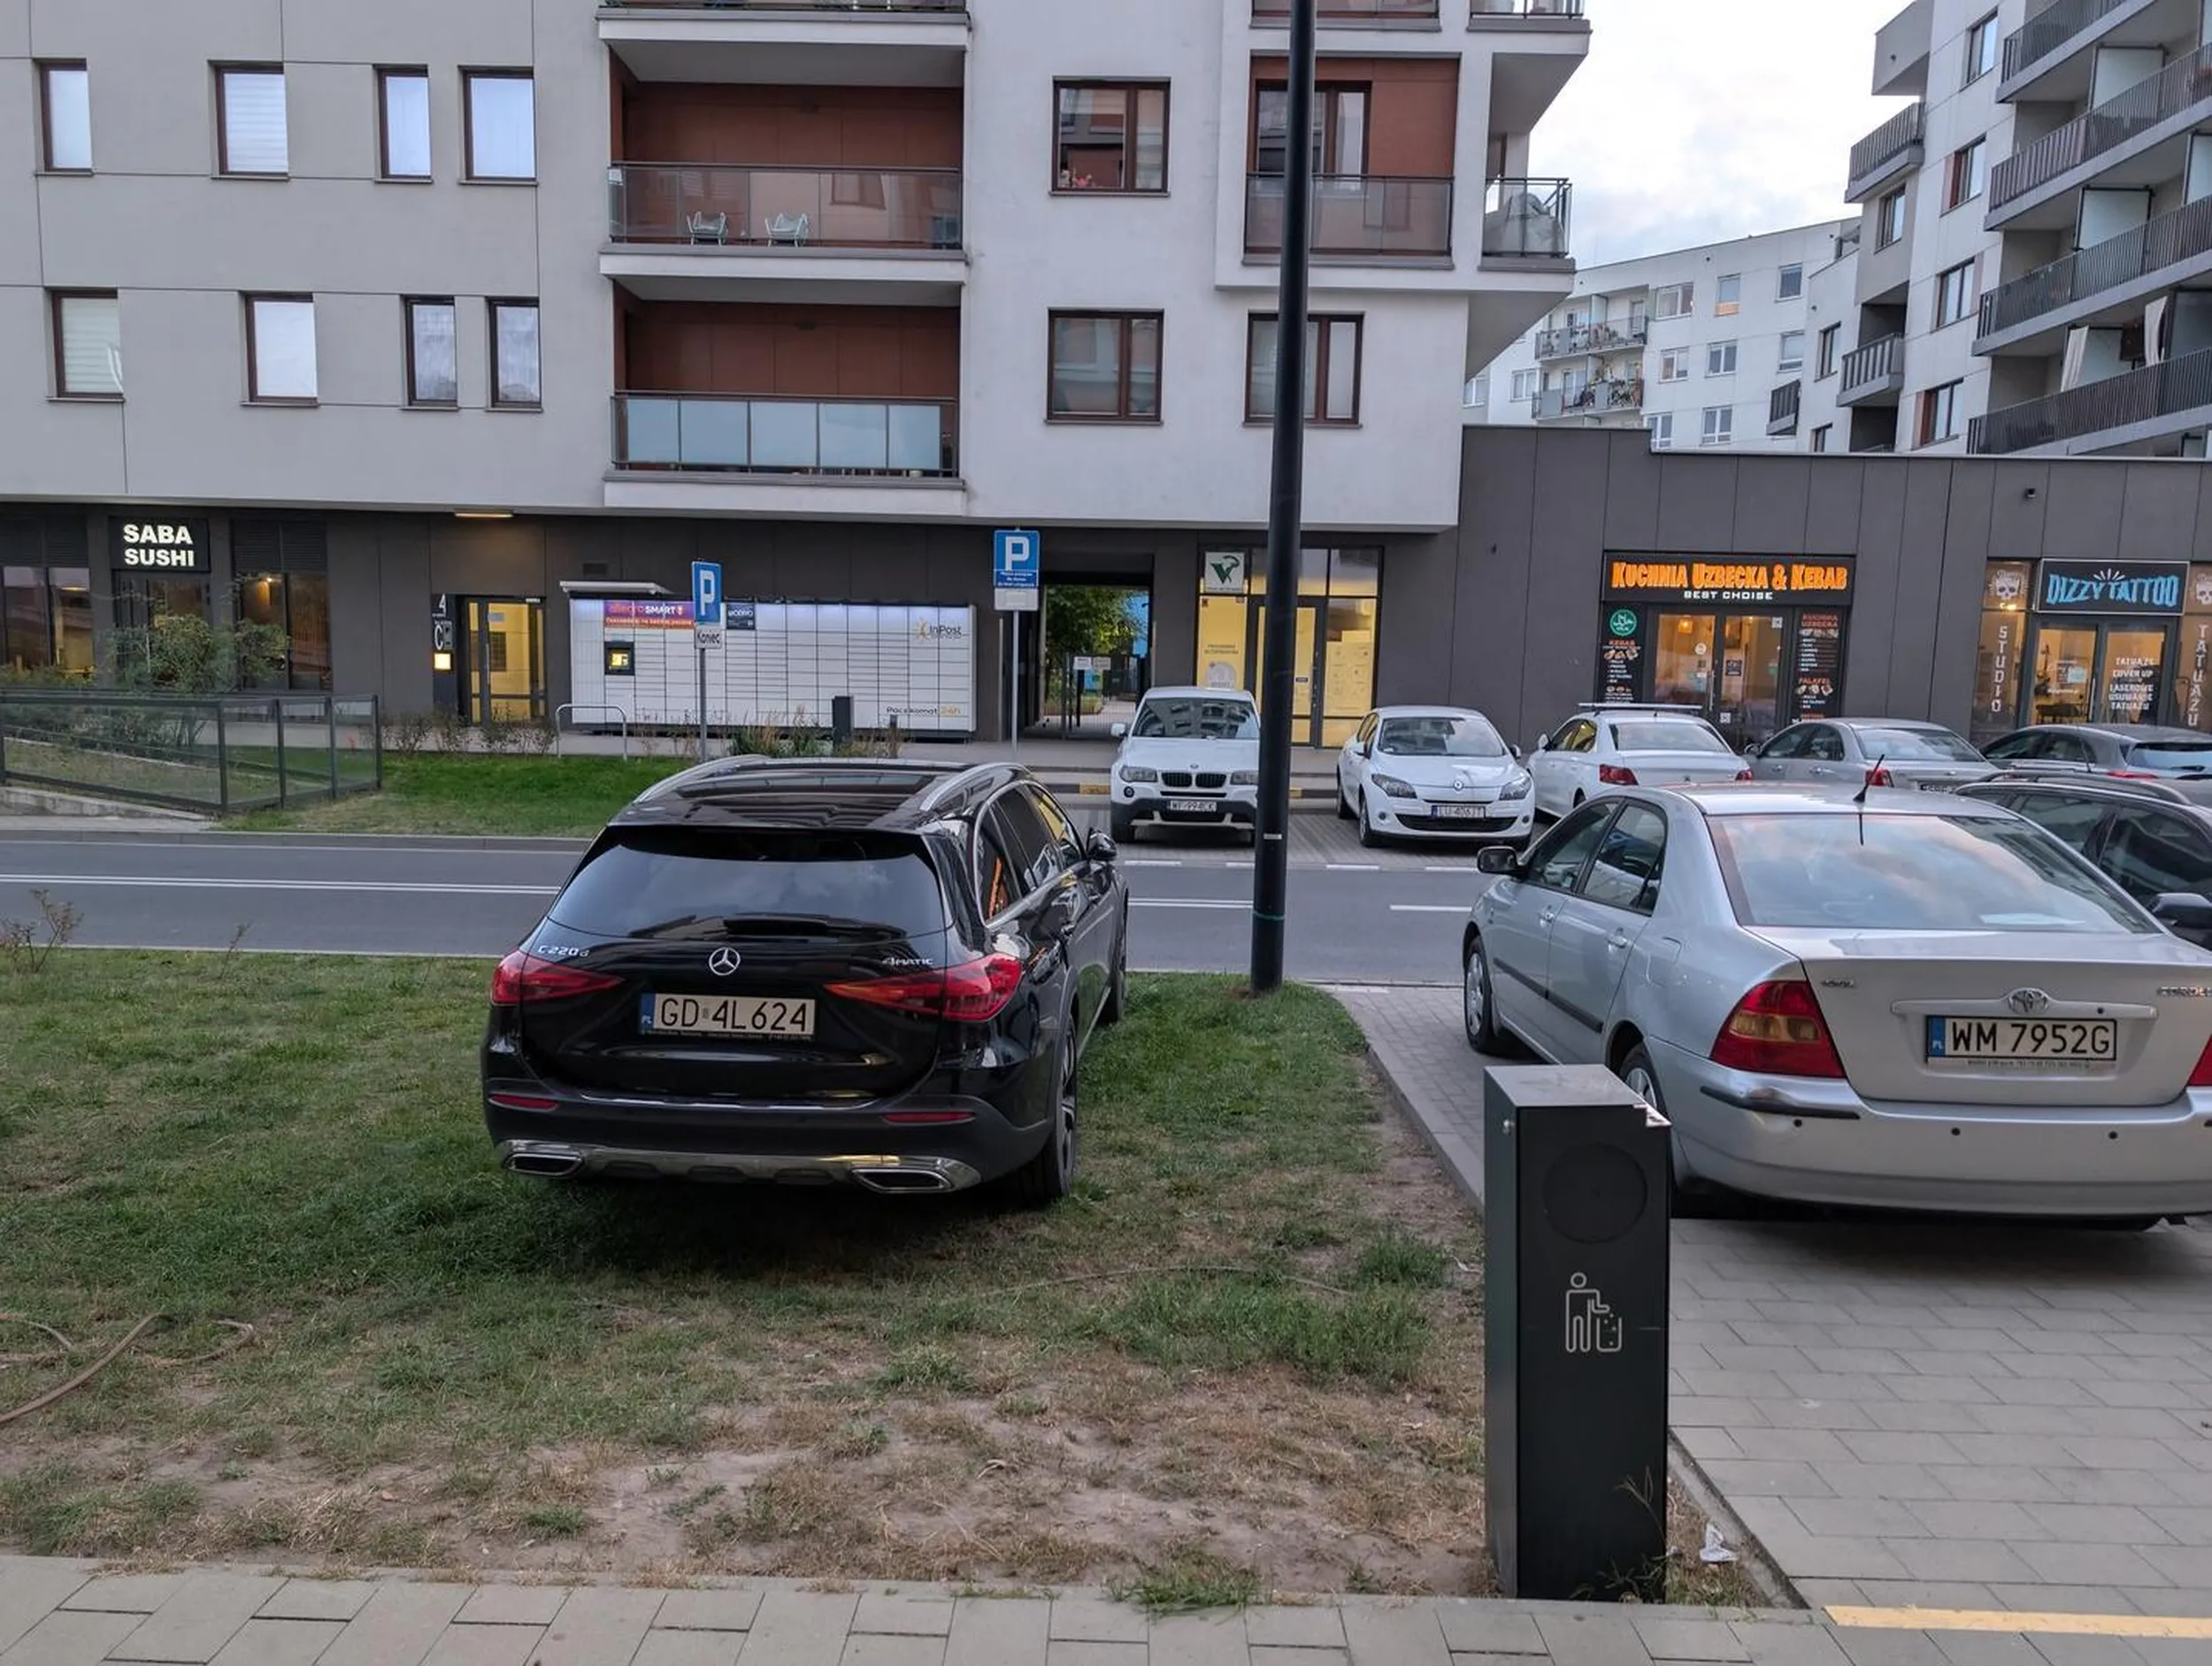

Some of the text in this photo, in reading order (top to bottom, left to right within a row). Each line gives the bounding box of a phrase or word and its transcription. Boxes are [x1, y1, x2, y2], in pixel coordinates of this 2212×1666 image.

[123, 524, 193, 544] SABA
[124, 549, 195, 566] SUSHI
[1005, 536, 1029, 571] P
[1612, 562, 1848, 591] KUCHNIA UZBECKA & KEBAB
[2047, 573, 2180, 607] DIZZY TATTOO
[699, 569, 715, 617] P
[1684, 590, 1773, 601] BEST CHOISE
[697, 630, 720, 645] Koniec
[929, 625, 962, 635] InPost
[1991, 625, 2009, 712] STUDIO
[661, 998, 807, 1033] GD 4L624
[1952, 1021, 2110, 1054] WM 7952G
